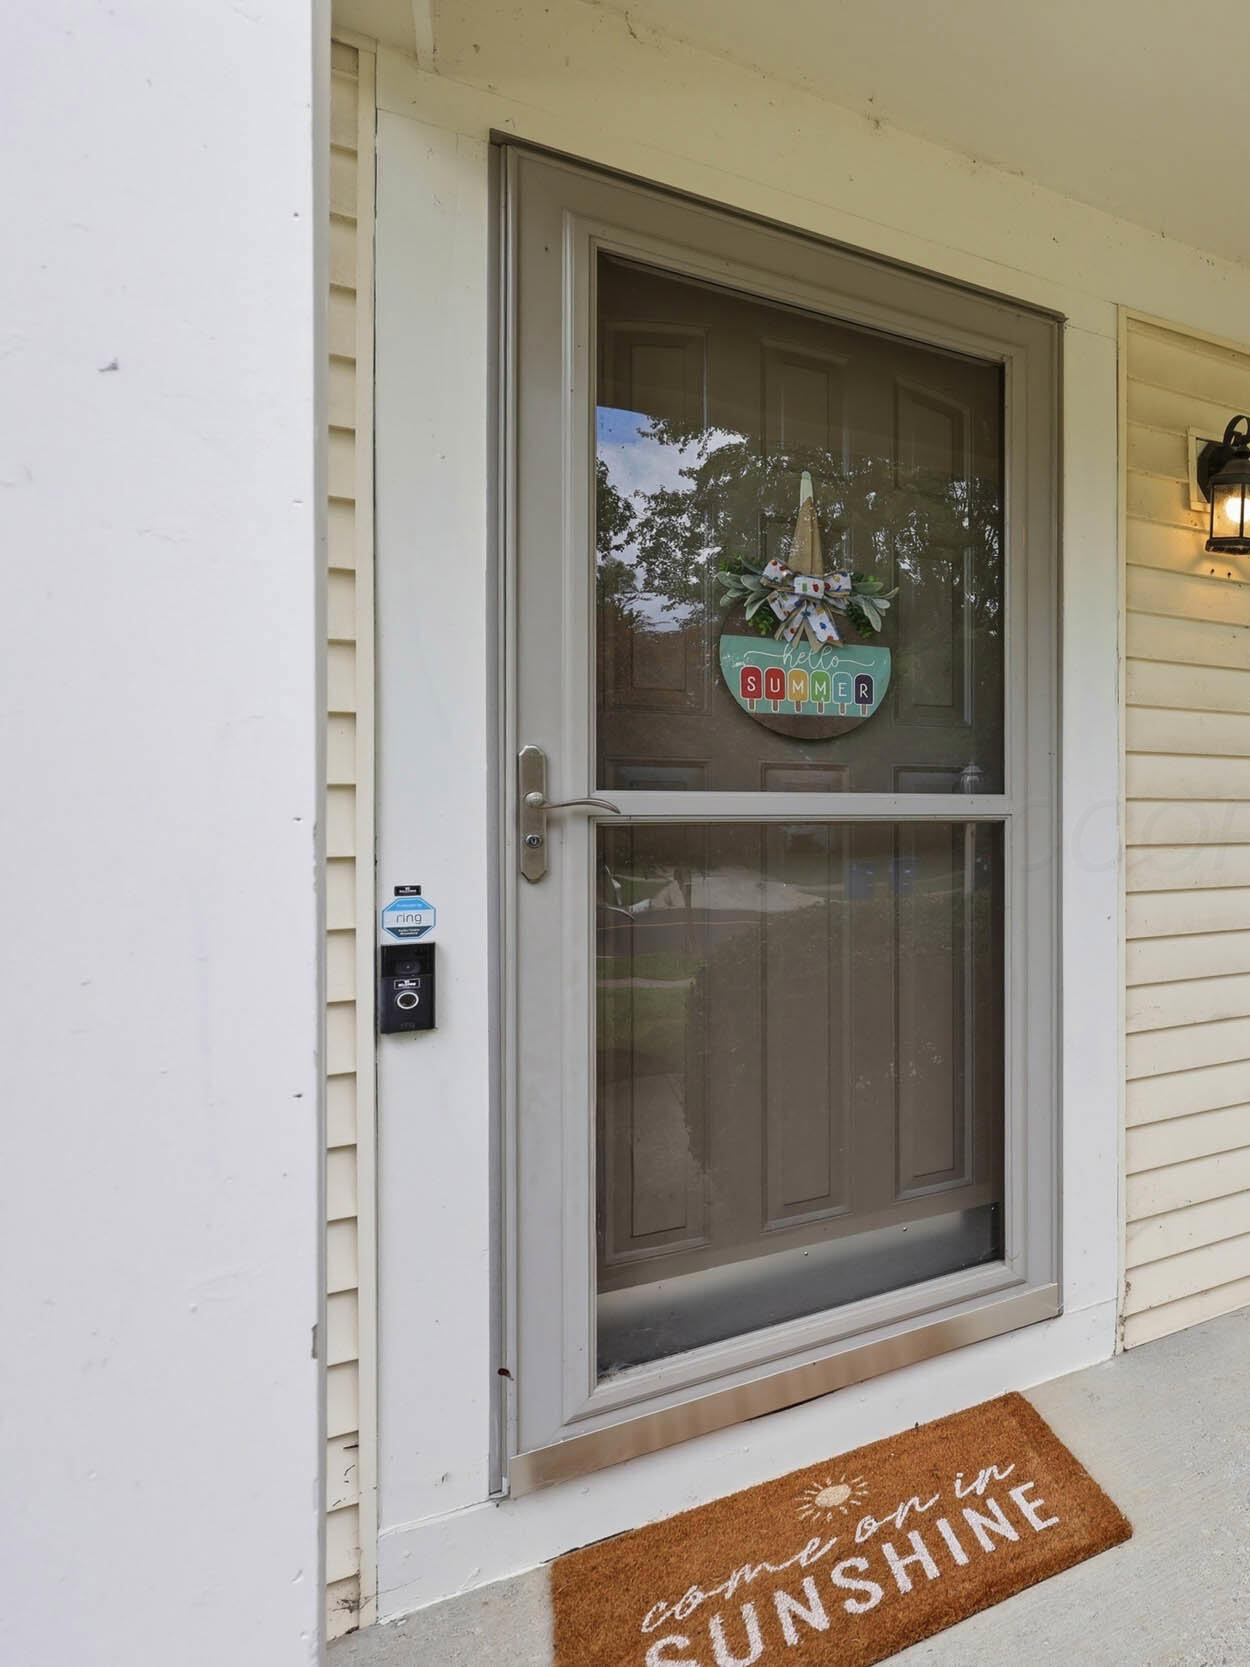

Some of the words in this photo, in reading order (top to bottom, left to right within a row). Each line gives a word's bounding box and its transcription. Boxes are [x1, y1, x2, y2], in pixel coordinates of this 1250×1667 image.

[746, 676, 869, 698] SUMMER
[396, 911, 422, 925] ring
[641, 1536, 839, 1633] come
[854, 1493, 941, 1544] on
[954, 1463, 1016, 1498] in
